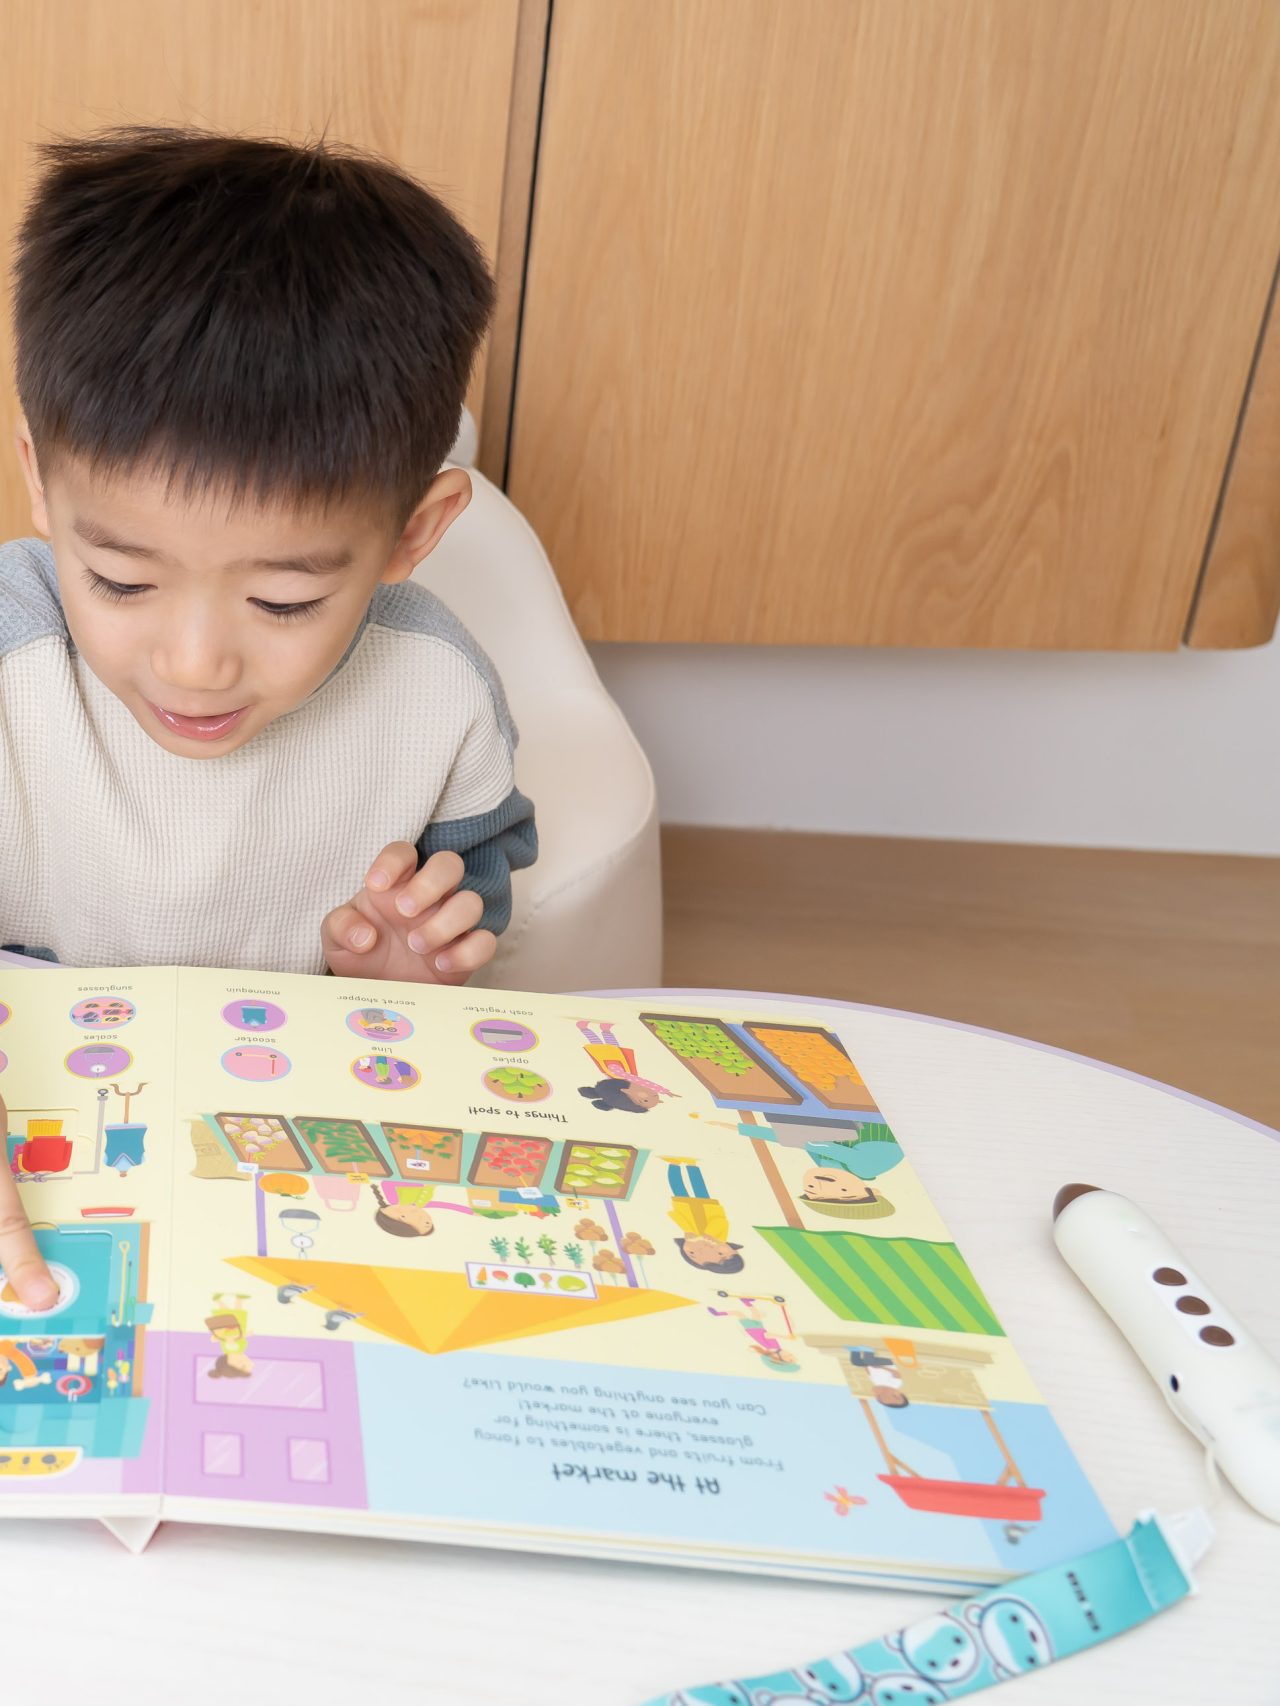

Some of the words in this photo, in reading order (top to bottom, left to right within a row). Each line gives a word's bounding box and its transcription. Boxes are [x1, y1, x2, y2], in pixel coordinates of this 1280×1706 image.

[78, 985, 133, 993] sunglasses
[226, 986, 280, 995] mannequin
[337, 993, 379, 1004] shopper
[381, 997, 416, 1007] secret
[463, 1005, 507, 1015] register
[509, 1007, 534, 1016] cash
[235, 1036, 276, 1044] scooter
[492, 1056, 529, 1065] apples
[468, 1106, 501, 1116] spot!
[505, 1109, 520, 1119] to
[524, 1109, 569, 1123] Things
[507, 1380, 555, 1395] would
[560, 1383, 589, 1397] you
[595, 1386, 666, 1405] anything
[671, 1394, 698, 1405] see
[519, 1400, 583, 1415] market!
[702, 1396, 728, 1410] you
[732, 1401, 767, 1416] Can
[588, 1404, 617, 1418] the
[620, 1408, 638, 1419] at
[645, 1409, 719, 1426] everyone
[494, 1415, 520, 1429] for
[524, 1416, 611, 1434] something
[474, 1428, 522, 1446] fancy
[615, 1424, 629, 1436] is
[633, 1427, 682, 1442] there
[526, 1435, 545, 1447] to
[549, 1435, 642, 1456] vegetables
[687, 1432, 754, 1449] glasses,
[648, 1447, 678, 1459] and
[684, 1450, 735, 1467] fruits
[739, 1458, 784, 1472] From
[551, 1462, 640, 1486] market
[646, 1470, 687, 1493] the
[694, 1476, 722, 1496] At
